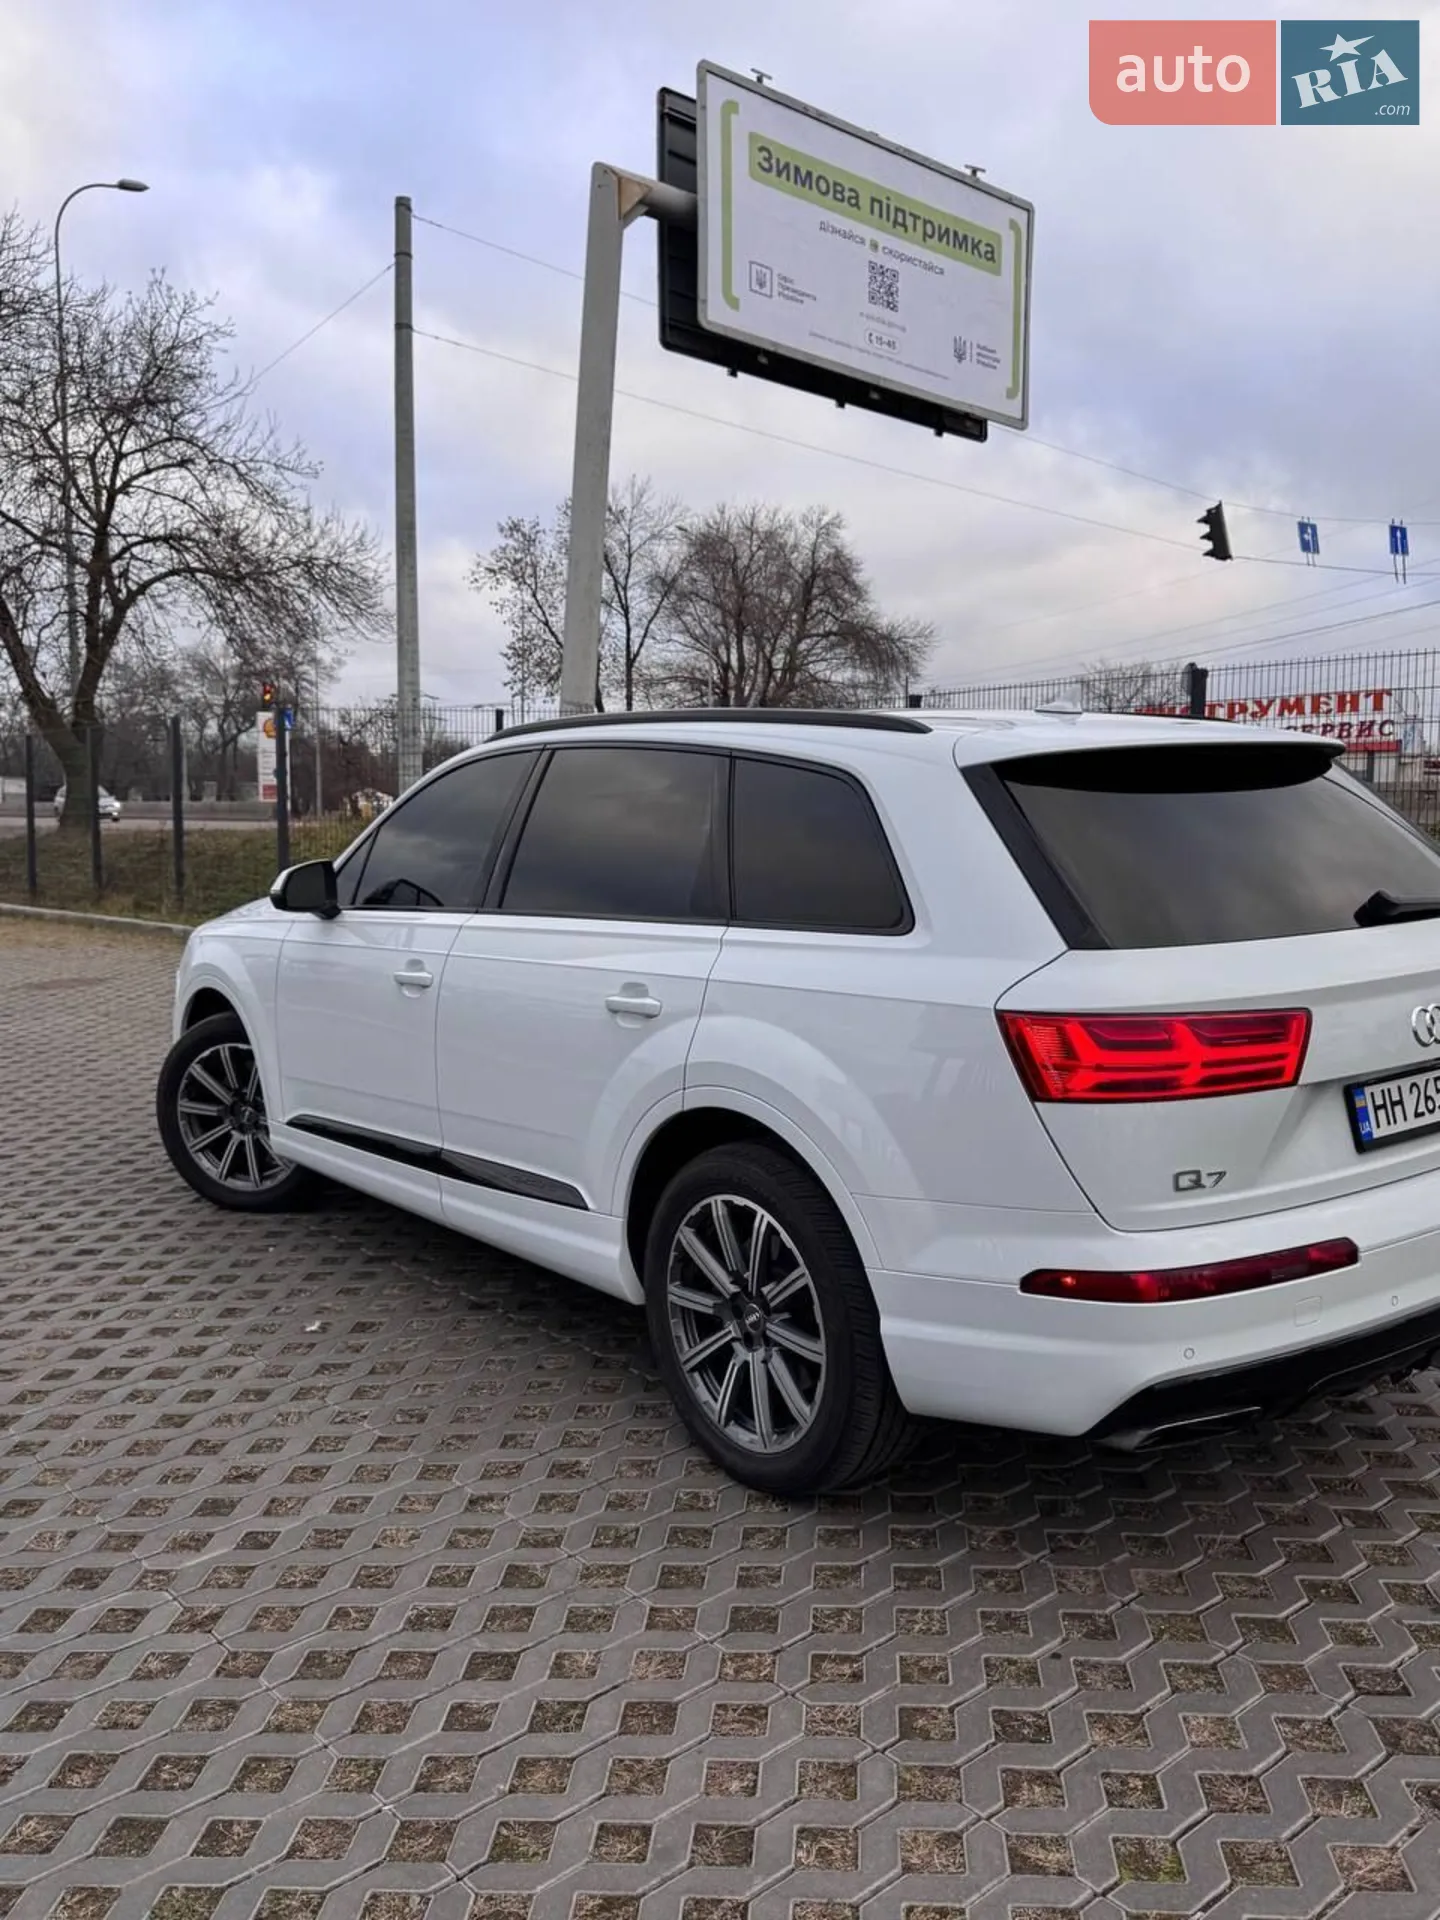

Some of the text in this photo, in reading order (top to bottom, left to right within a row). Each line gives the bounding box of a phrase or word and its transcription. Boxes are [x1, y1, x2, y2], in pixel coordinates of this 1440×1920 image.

[757, 146, 996, 264] Зимова підтримка
[819, 220, 945, 276] дізнайся скористайся
[1134, 689, 1393, 720] ТРУМЕНТ
[1370, 1085, 1407, 1129] HH
[1173, 1169, 1227, 1192] Q7
